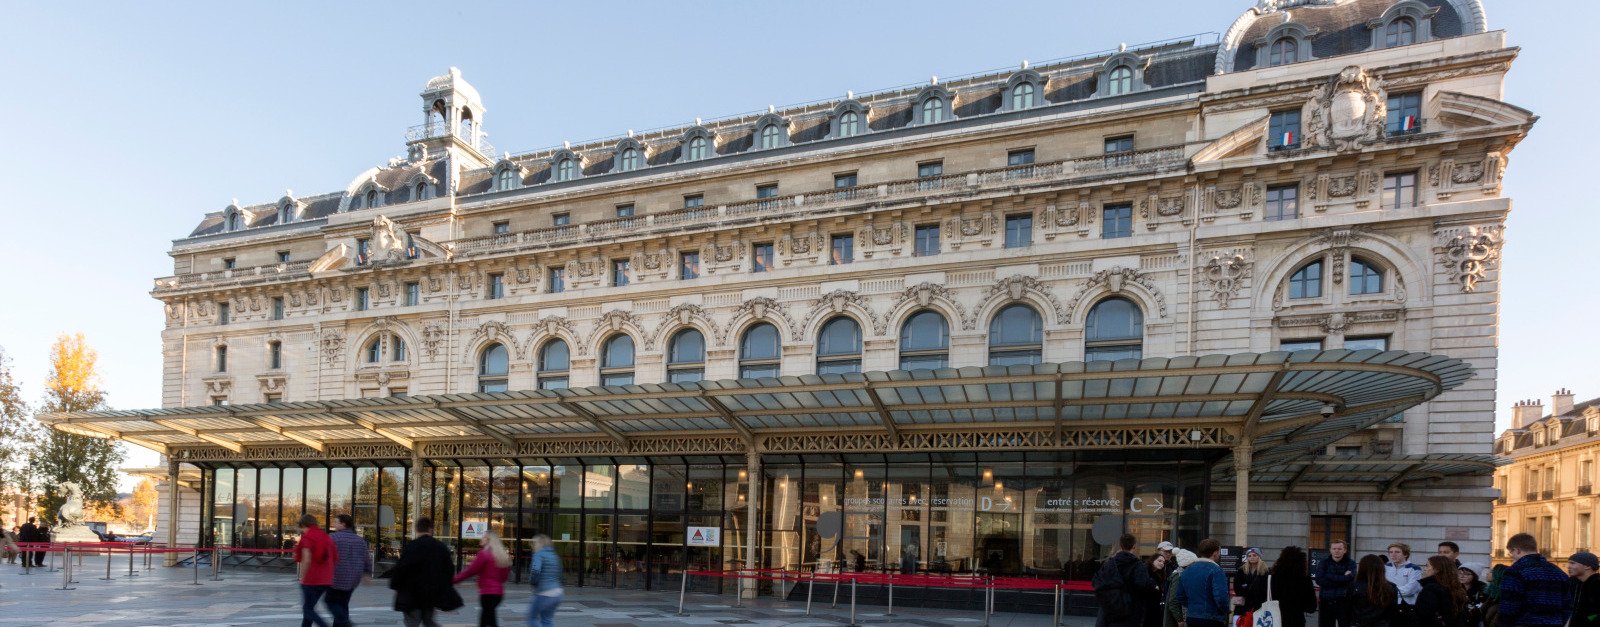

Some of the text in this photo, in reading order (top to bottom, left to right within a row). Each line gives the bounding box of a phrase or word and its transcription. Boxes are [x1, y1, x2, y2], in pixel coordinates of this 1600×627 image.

[872, 497, 907, 505] scoaires
[930, 497, 974, 505] réservation
[981, 496, 992, 511] D
[1047, 497, 1143, 513] entrée réservée C
